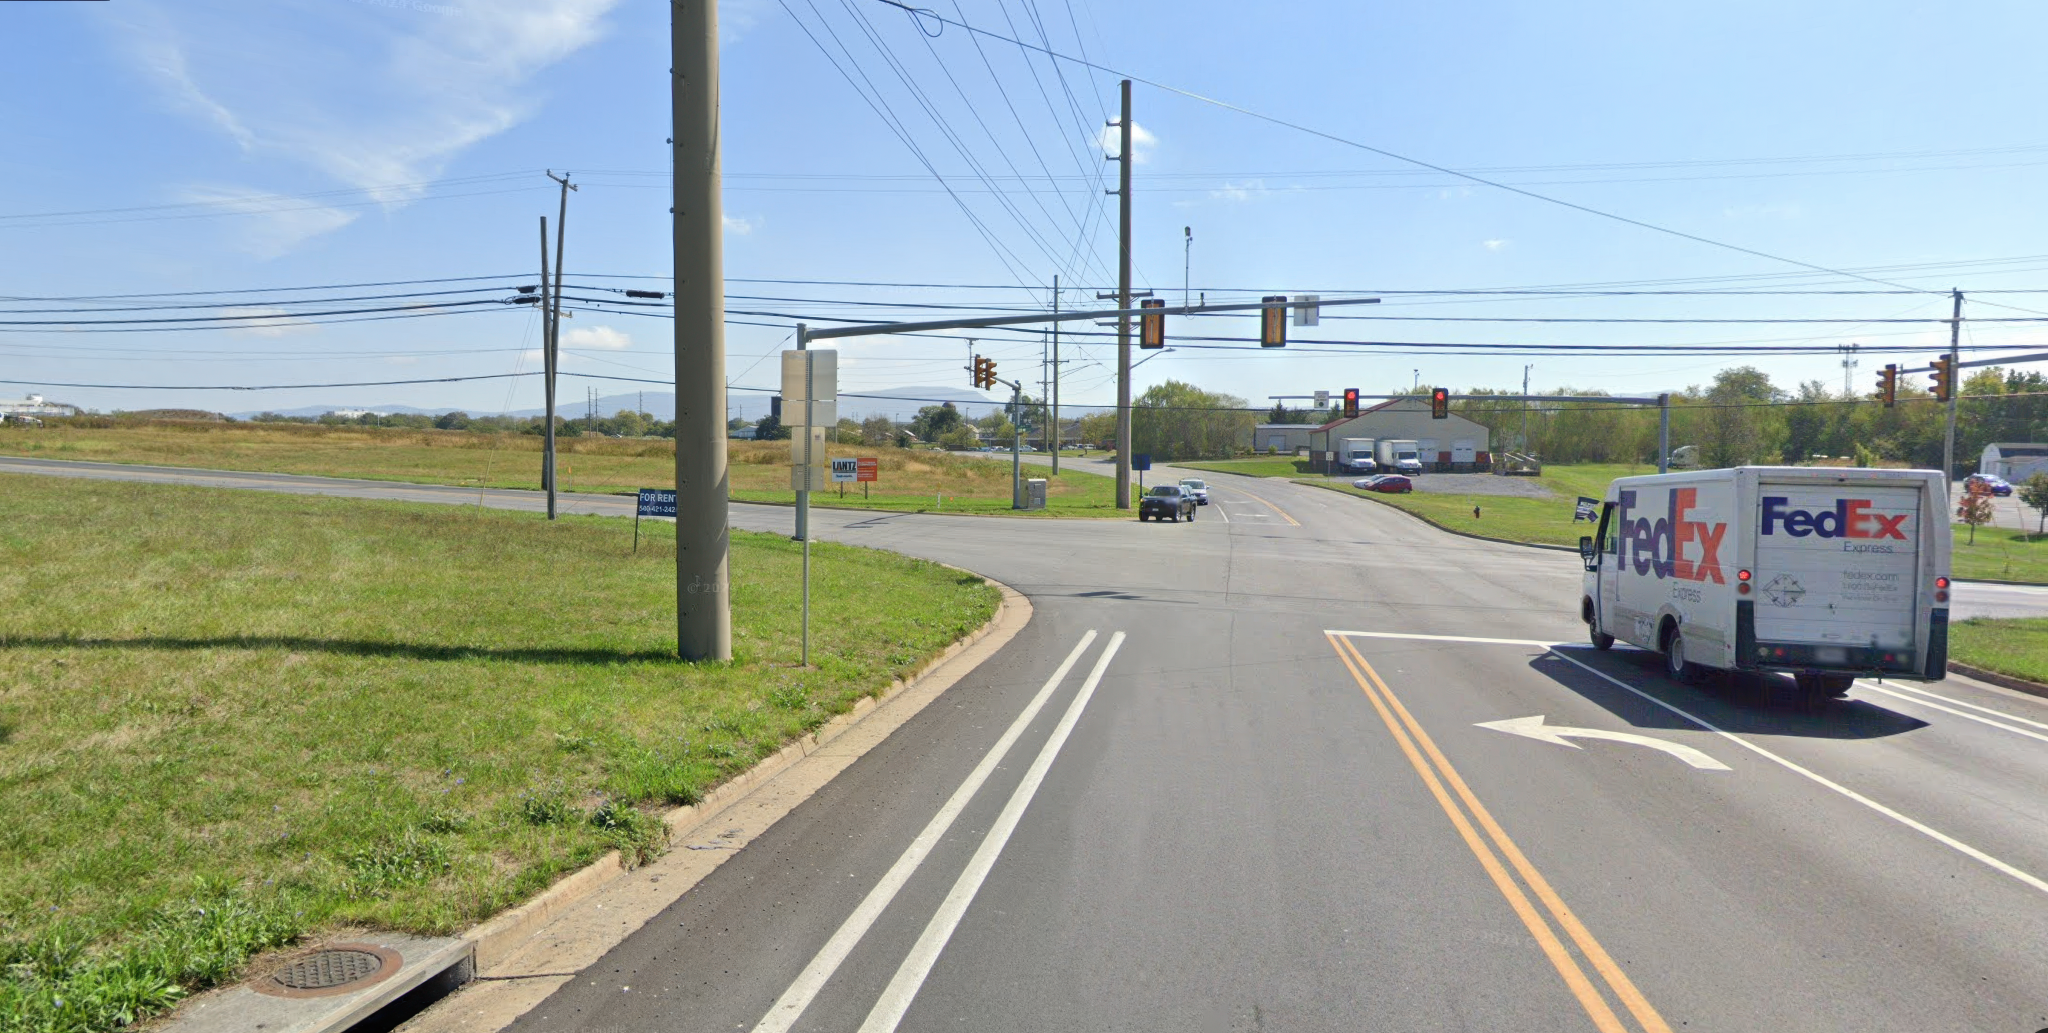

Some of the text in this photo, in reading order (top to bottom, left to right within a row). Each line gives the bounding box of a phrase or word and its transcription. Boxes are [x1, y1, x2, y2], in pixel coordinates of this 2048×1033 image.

[832, 461, 857, 470] LANTZ
[640, 493, 656, 502] FOR
[1761, 496, 1909, 540] FedEx
[1618, 487, 1728, 585] FedEx
[1843, 541, 1893, 554] Express
[1673, 582, 1702, 603] Express
